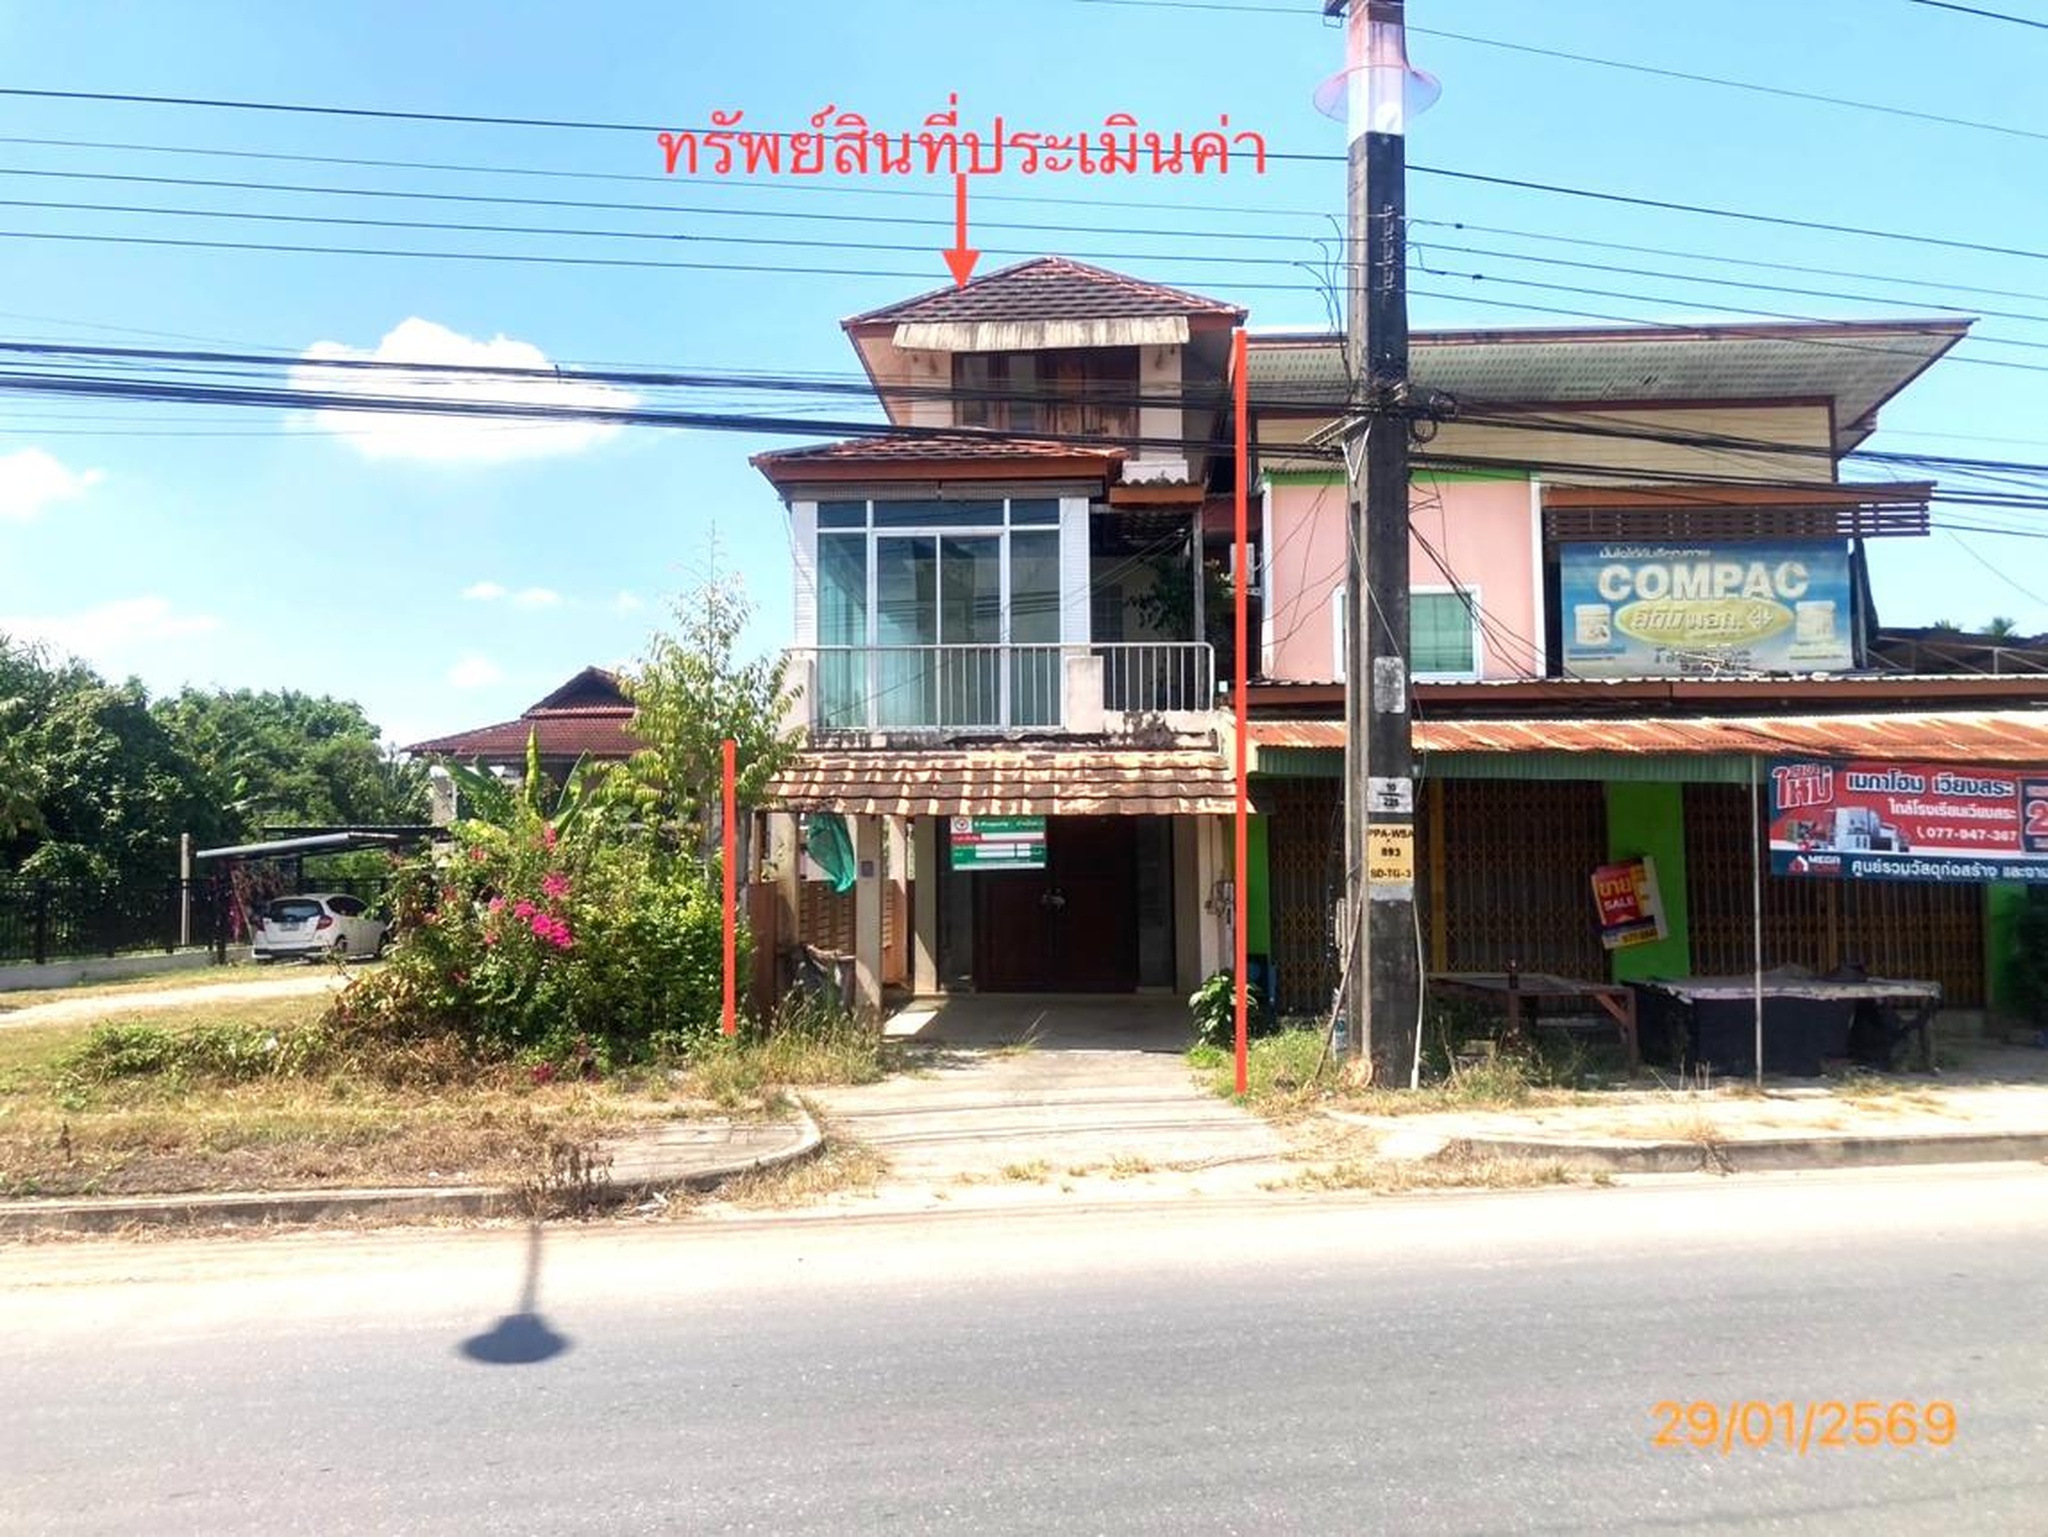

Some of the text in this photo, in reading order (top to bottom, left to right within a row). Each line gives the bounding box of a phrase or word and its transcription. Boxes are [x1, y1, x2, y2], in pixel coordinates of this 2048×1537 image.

[1598, 562, 1810, 601] COMPAC
[1847, 769, 1926, 794] เมกาโฮม
[1931, 771, 2016, 797] เวียงสระ
[1852, 858, 1998, 880] ศูนย์รวมวัสดุก่อสร้าง
[1603, 896, 1636, 911] SALE
